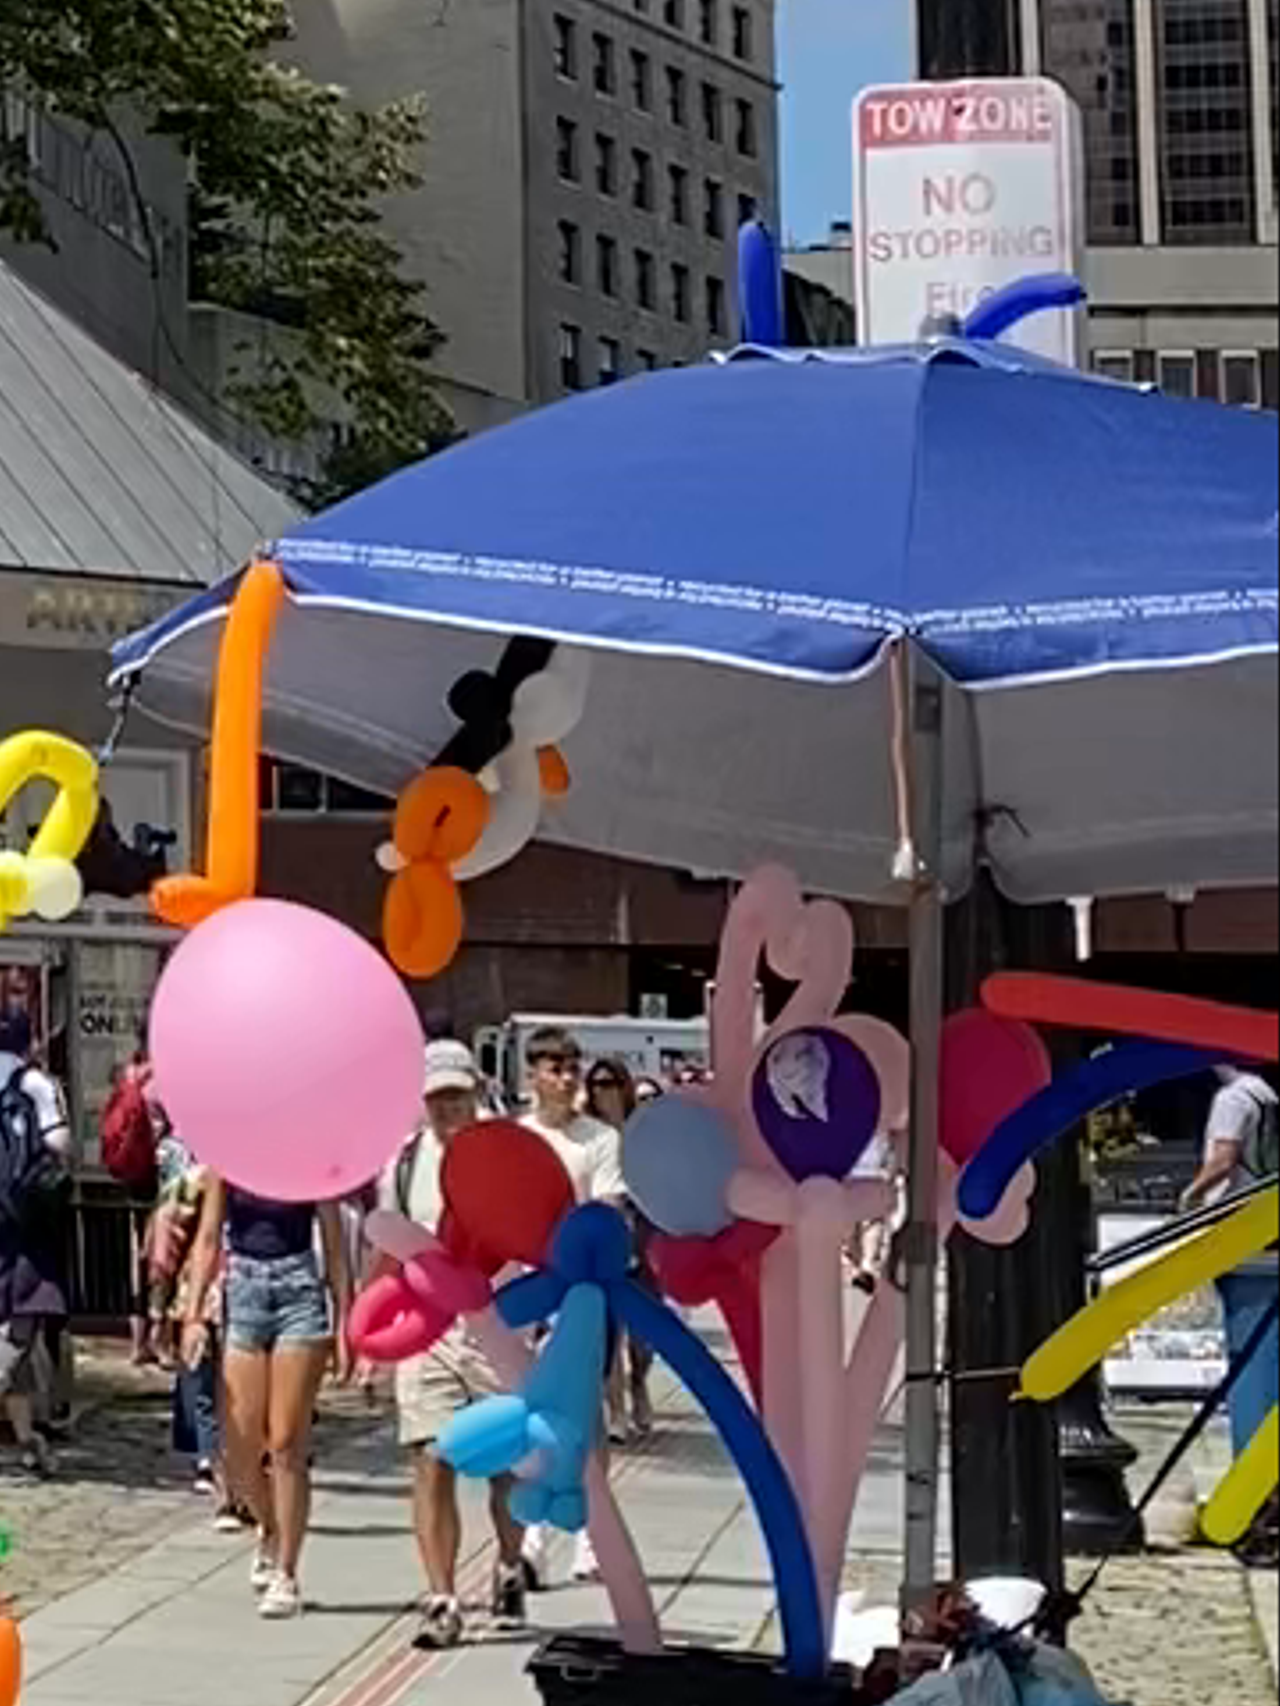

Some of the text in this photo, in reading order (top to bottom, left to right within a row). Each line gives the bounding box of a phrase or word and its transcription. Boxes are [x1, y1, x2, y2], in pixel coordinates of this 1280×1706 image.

[866, 96, 1053, 136] TOW ZONE
[921, 172, 996, 217] NO
[870, 226, 1053, 263] STOPPING
